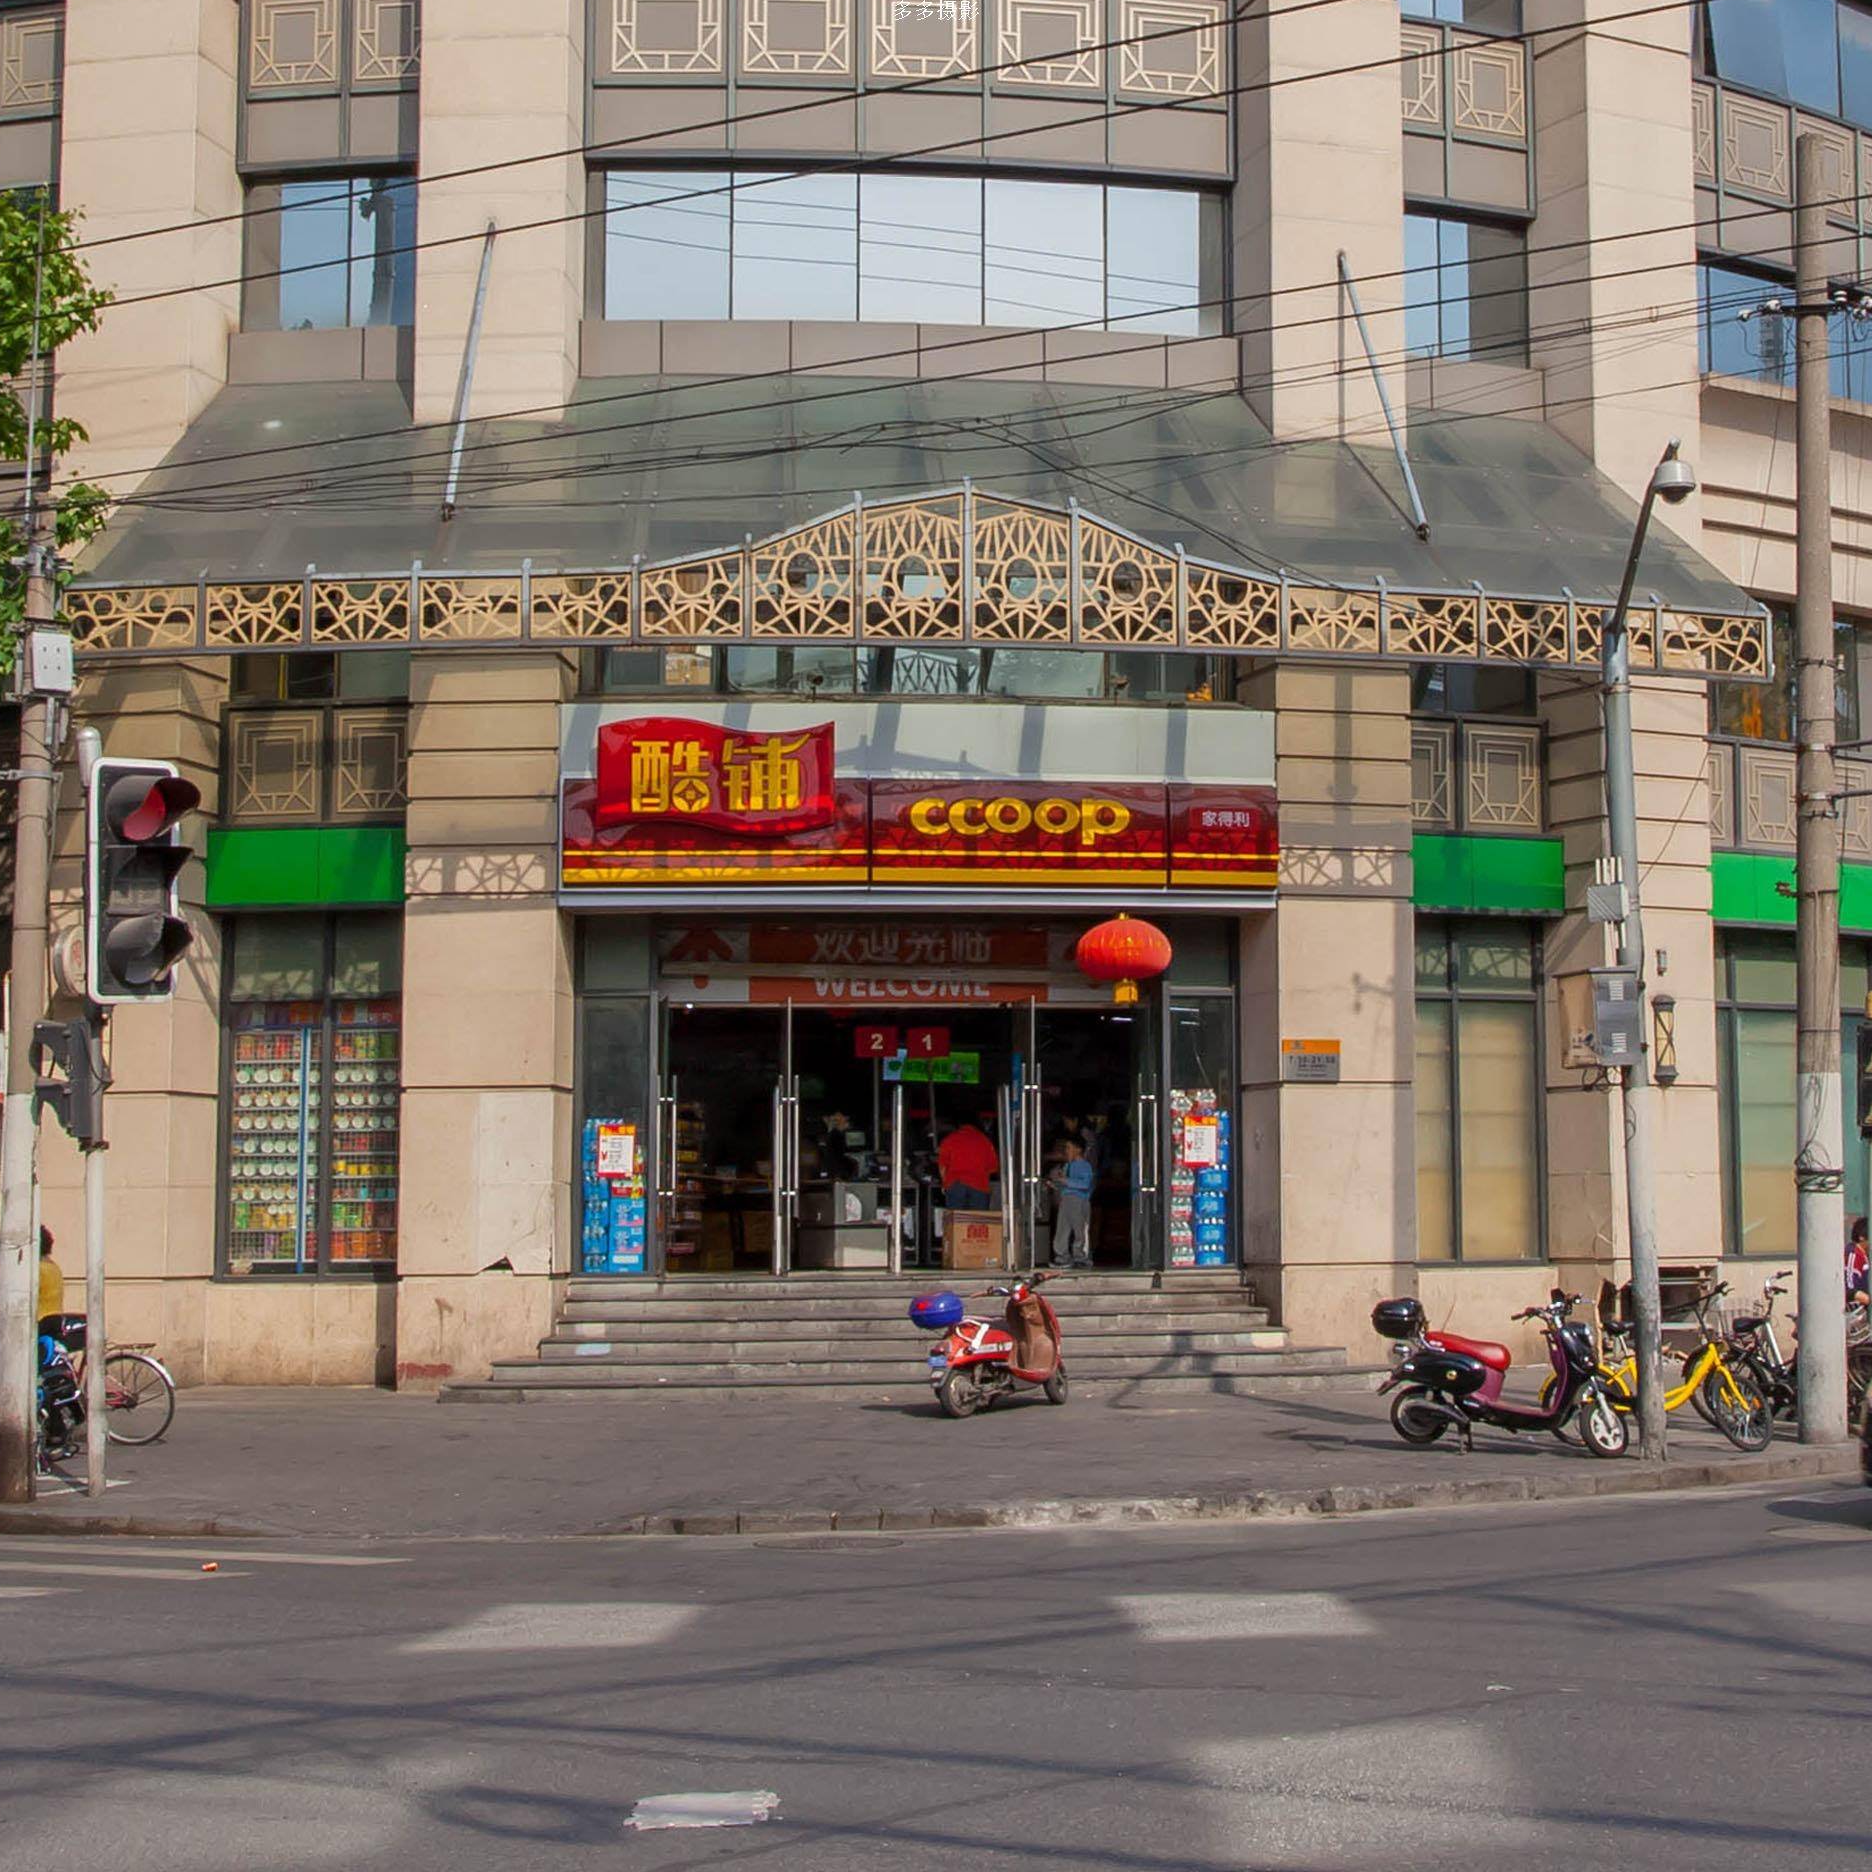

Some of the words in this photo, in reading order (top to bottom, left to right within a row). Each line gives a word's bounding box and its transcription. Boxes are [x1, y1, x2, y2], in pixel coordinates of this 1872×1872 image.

[631, 733, 812, 813] 酷铺
[1201, 810, 1251, 828] 家得利
[811, 927, 993, 963] 欢迎光临
[814, 976, 991, 998] WELCOME
[870, 1033, 884, 1050] 2
[921, 1034, 932, 1051] 1
